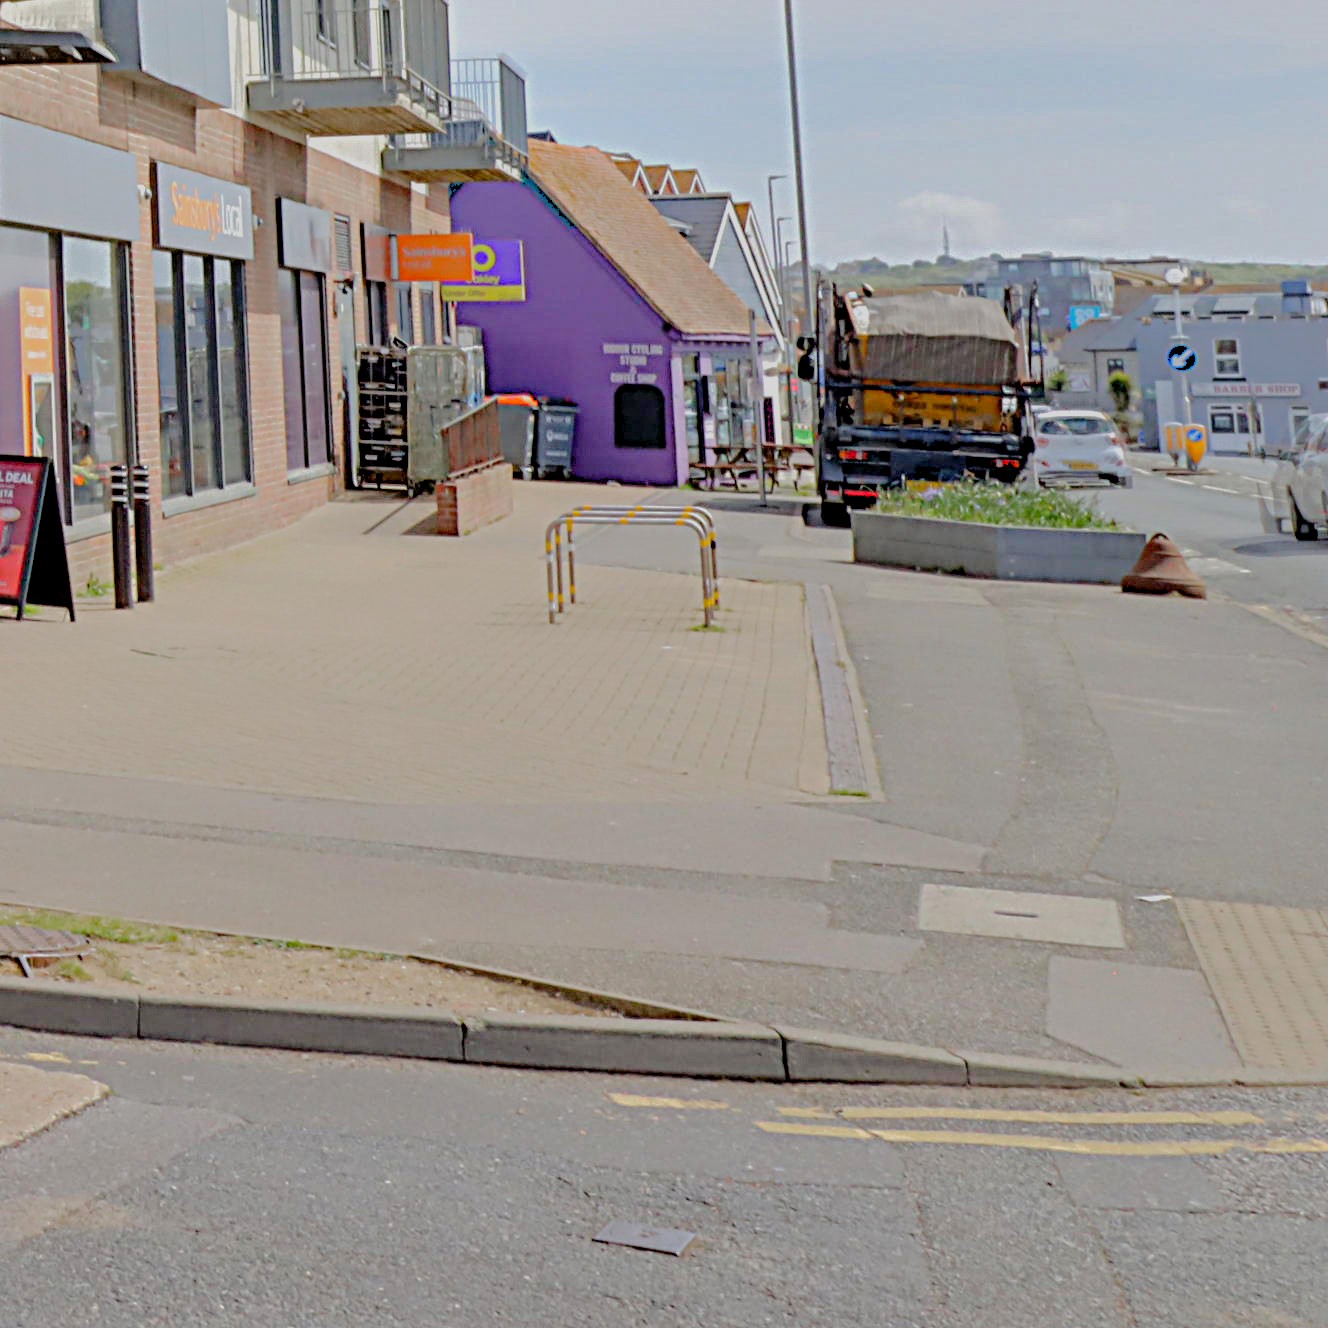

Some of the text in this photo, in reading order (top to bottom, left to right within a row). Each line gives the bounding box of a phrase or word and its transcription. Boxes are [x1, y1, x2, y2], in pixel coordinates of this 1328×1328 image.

[170, 182, 244, 242] Sainsbury's Local
[5, 471, 34, 485] DEAL
